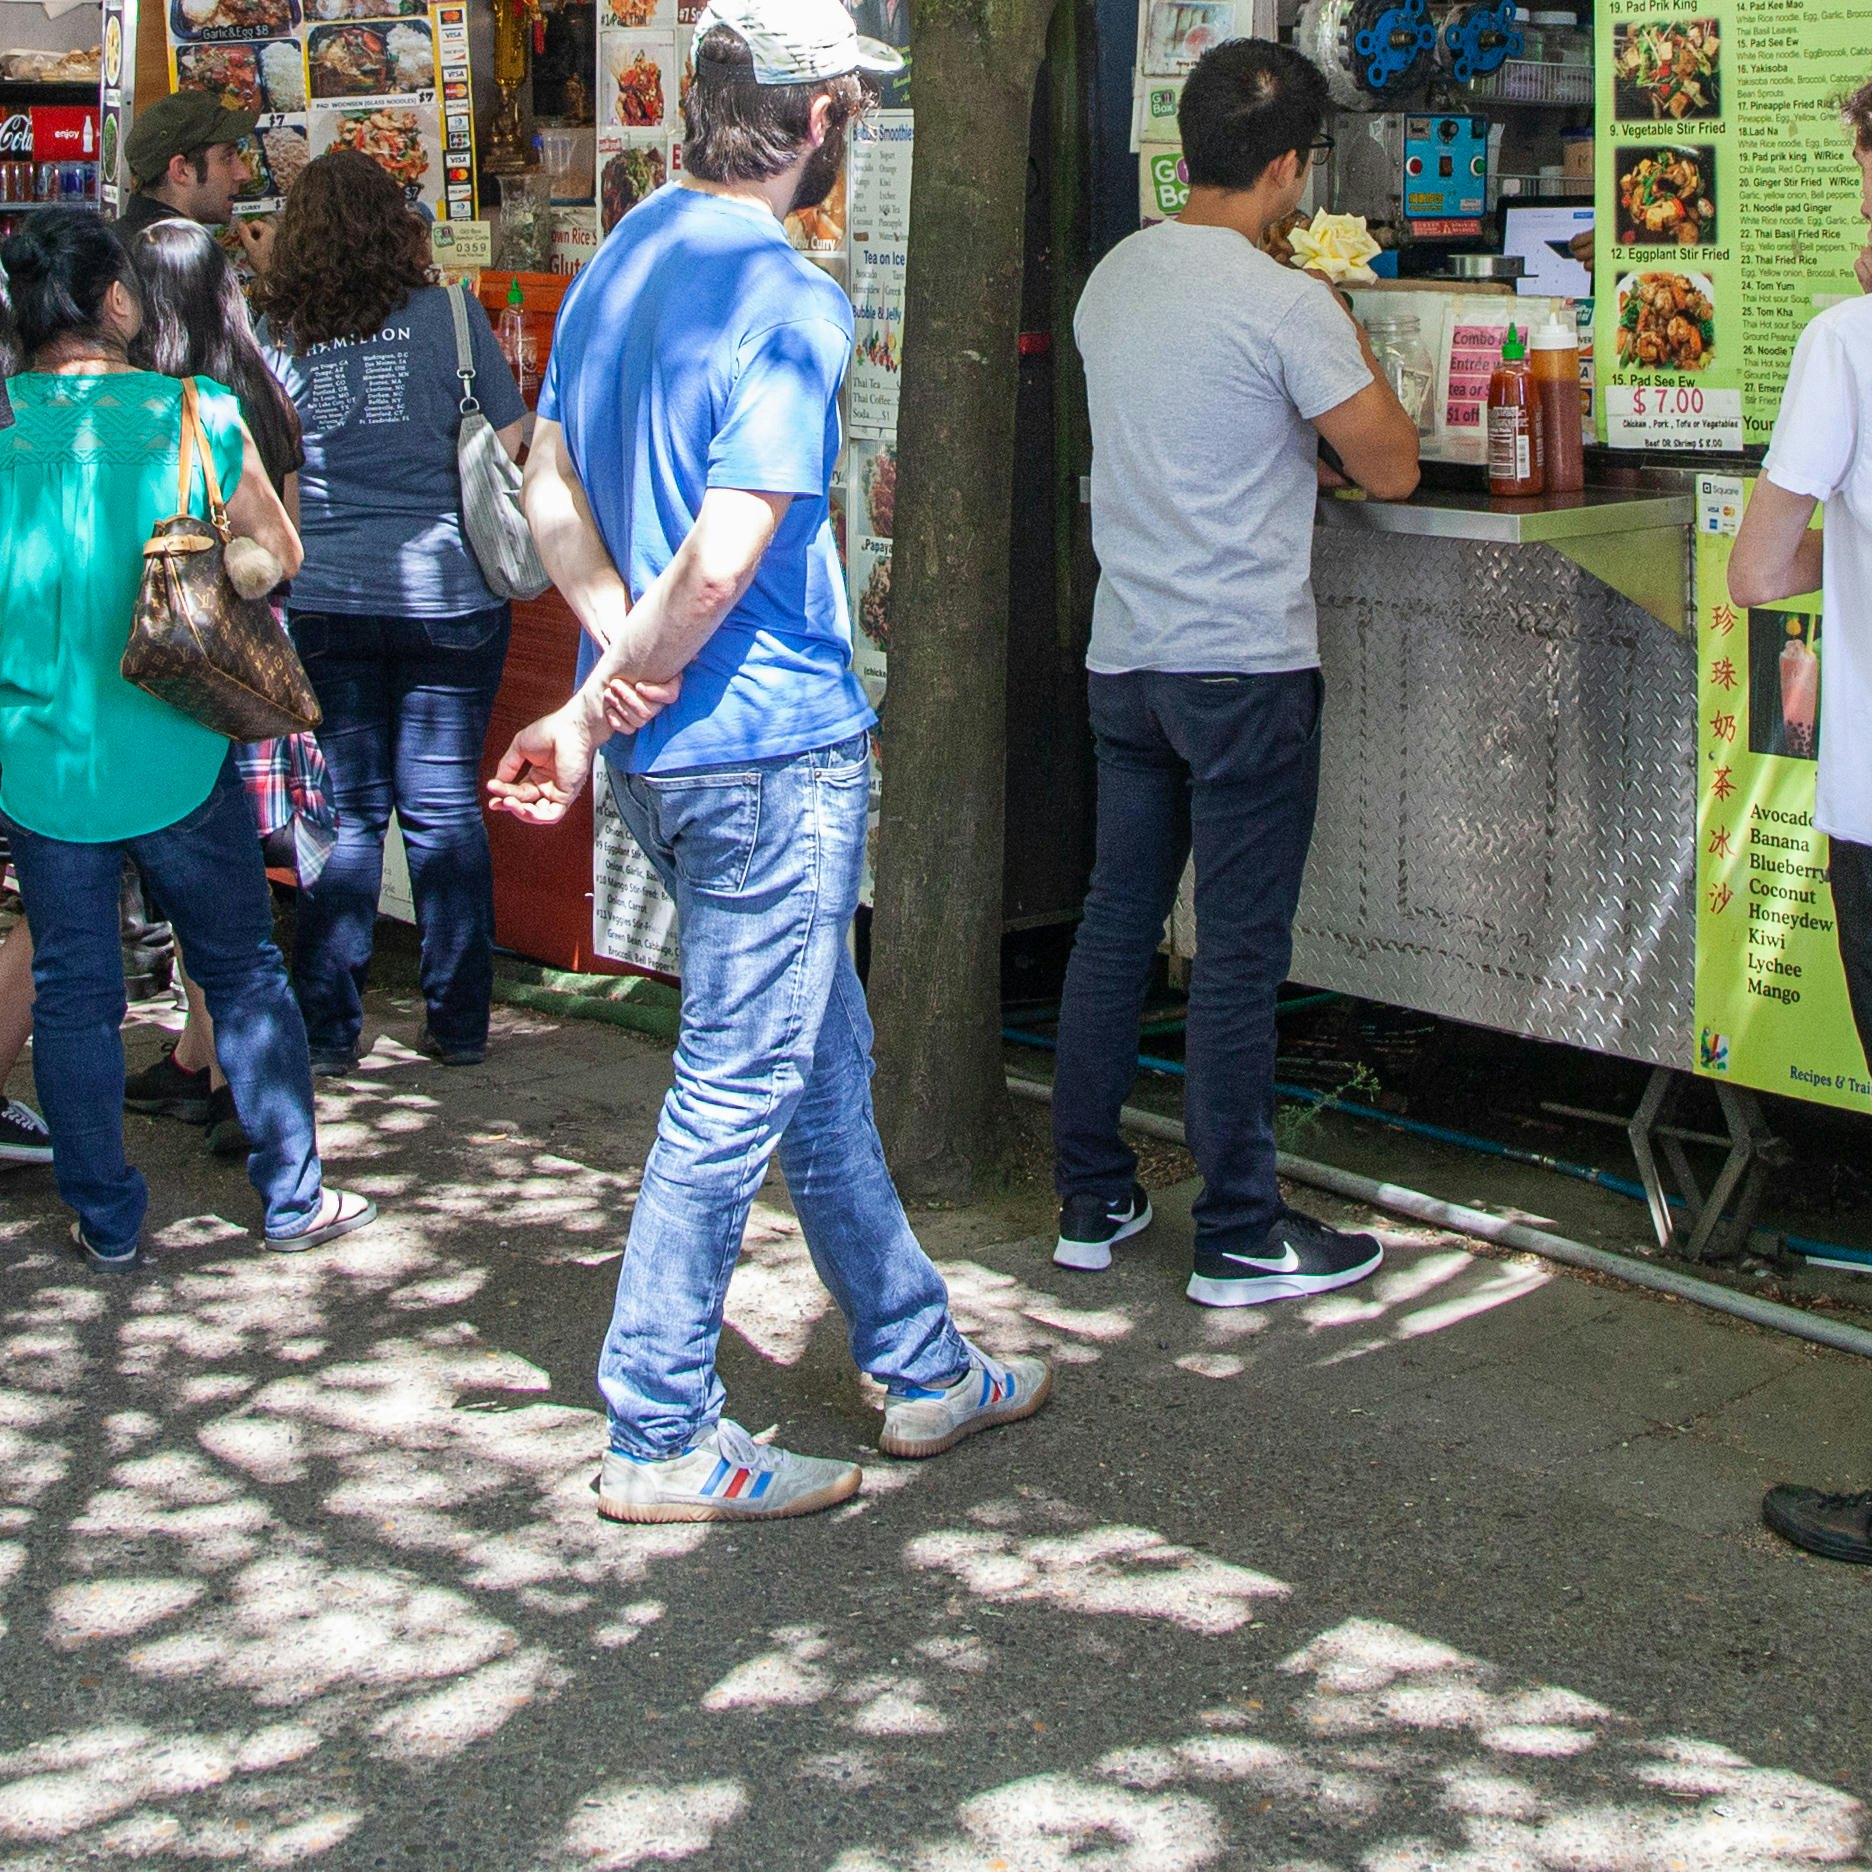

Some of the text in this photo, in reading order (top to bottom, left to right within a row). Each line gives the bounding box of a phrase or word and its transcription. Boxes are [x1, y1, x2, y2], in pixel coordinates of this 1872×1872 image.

[54, 130, 80, 141] enjoy
[1610, 119, 1726, 139] 9. Vegetable Stir Fried
[456, 242, 487, 253] 0359
[1611, 247, 1730, 262] 12. Eggplant Stir Fried
[863, 250, 905, 266] Tea on Ice
[1453, 331, 1495, 345] Combo
[1451, 355, 1490, 371] Entrée
[1470, 386, 1483, 396] or
[1612, 374, 1696, 389] 15. Pad See Ew
[1633, 387, 1704, 415] $ 7.00
[1742, 415, 1774, 431] Your
[1750, 828, 1810, 854] Banana
[1749, 853, 1828, 884] Blueberry
[1749, 878, 1816, 905] Coconut
[1748, 903, 1833, 933] Honeydew
[1748, 927, 1786, 951] Kiwi
[1747, 951, 1803, 979] Lychee
[1747, 976, 1801, 1005] Mango
[1790, 1065, 1832, 1088] Recipes
